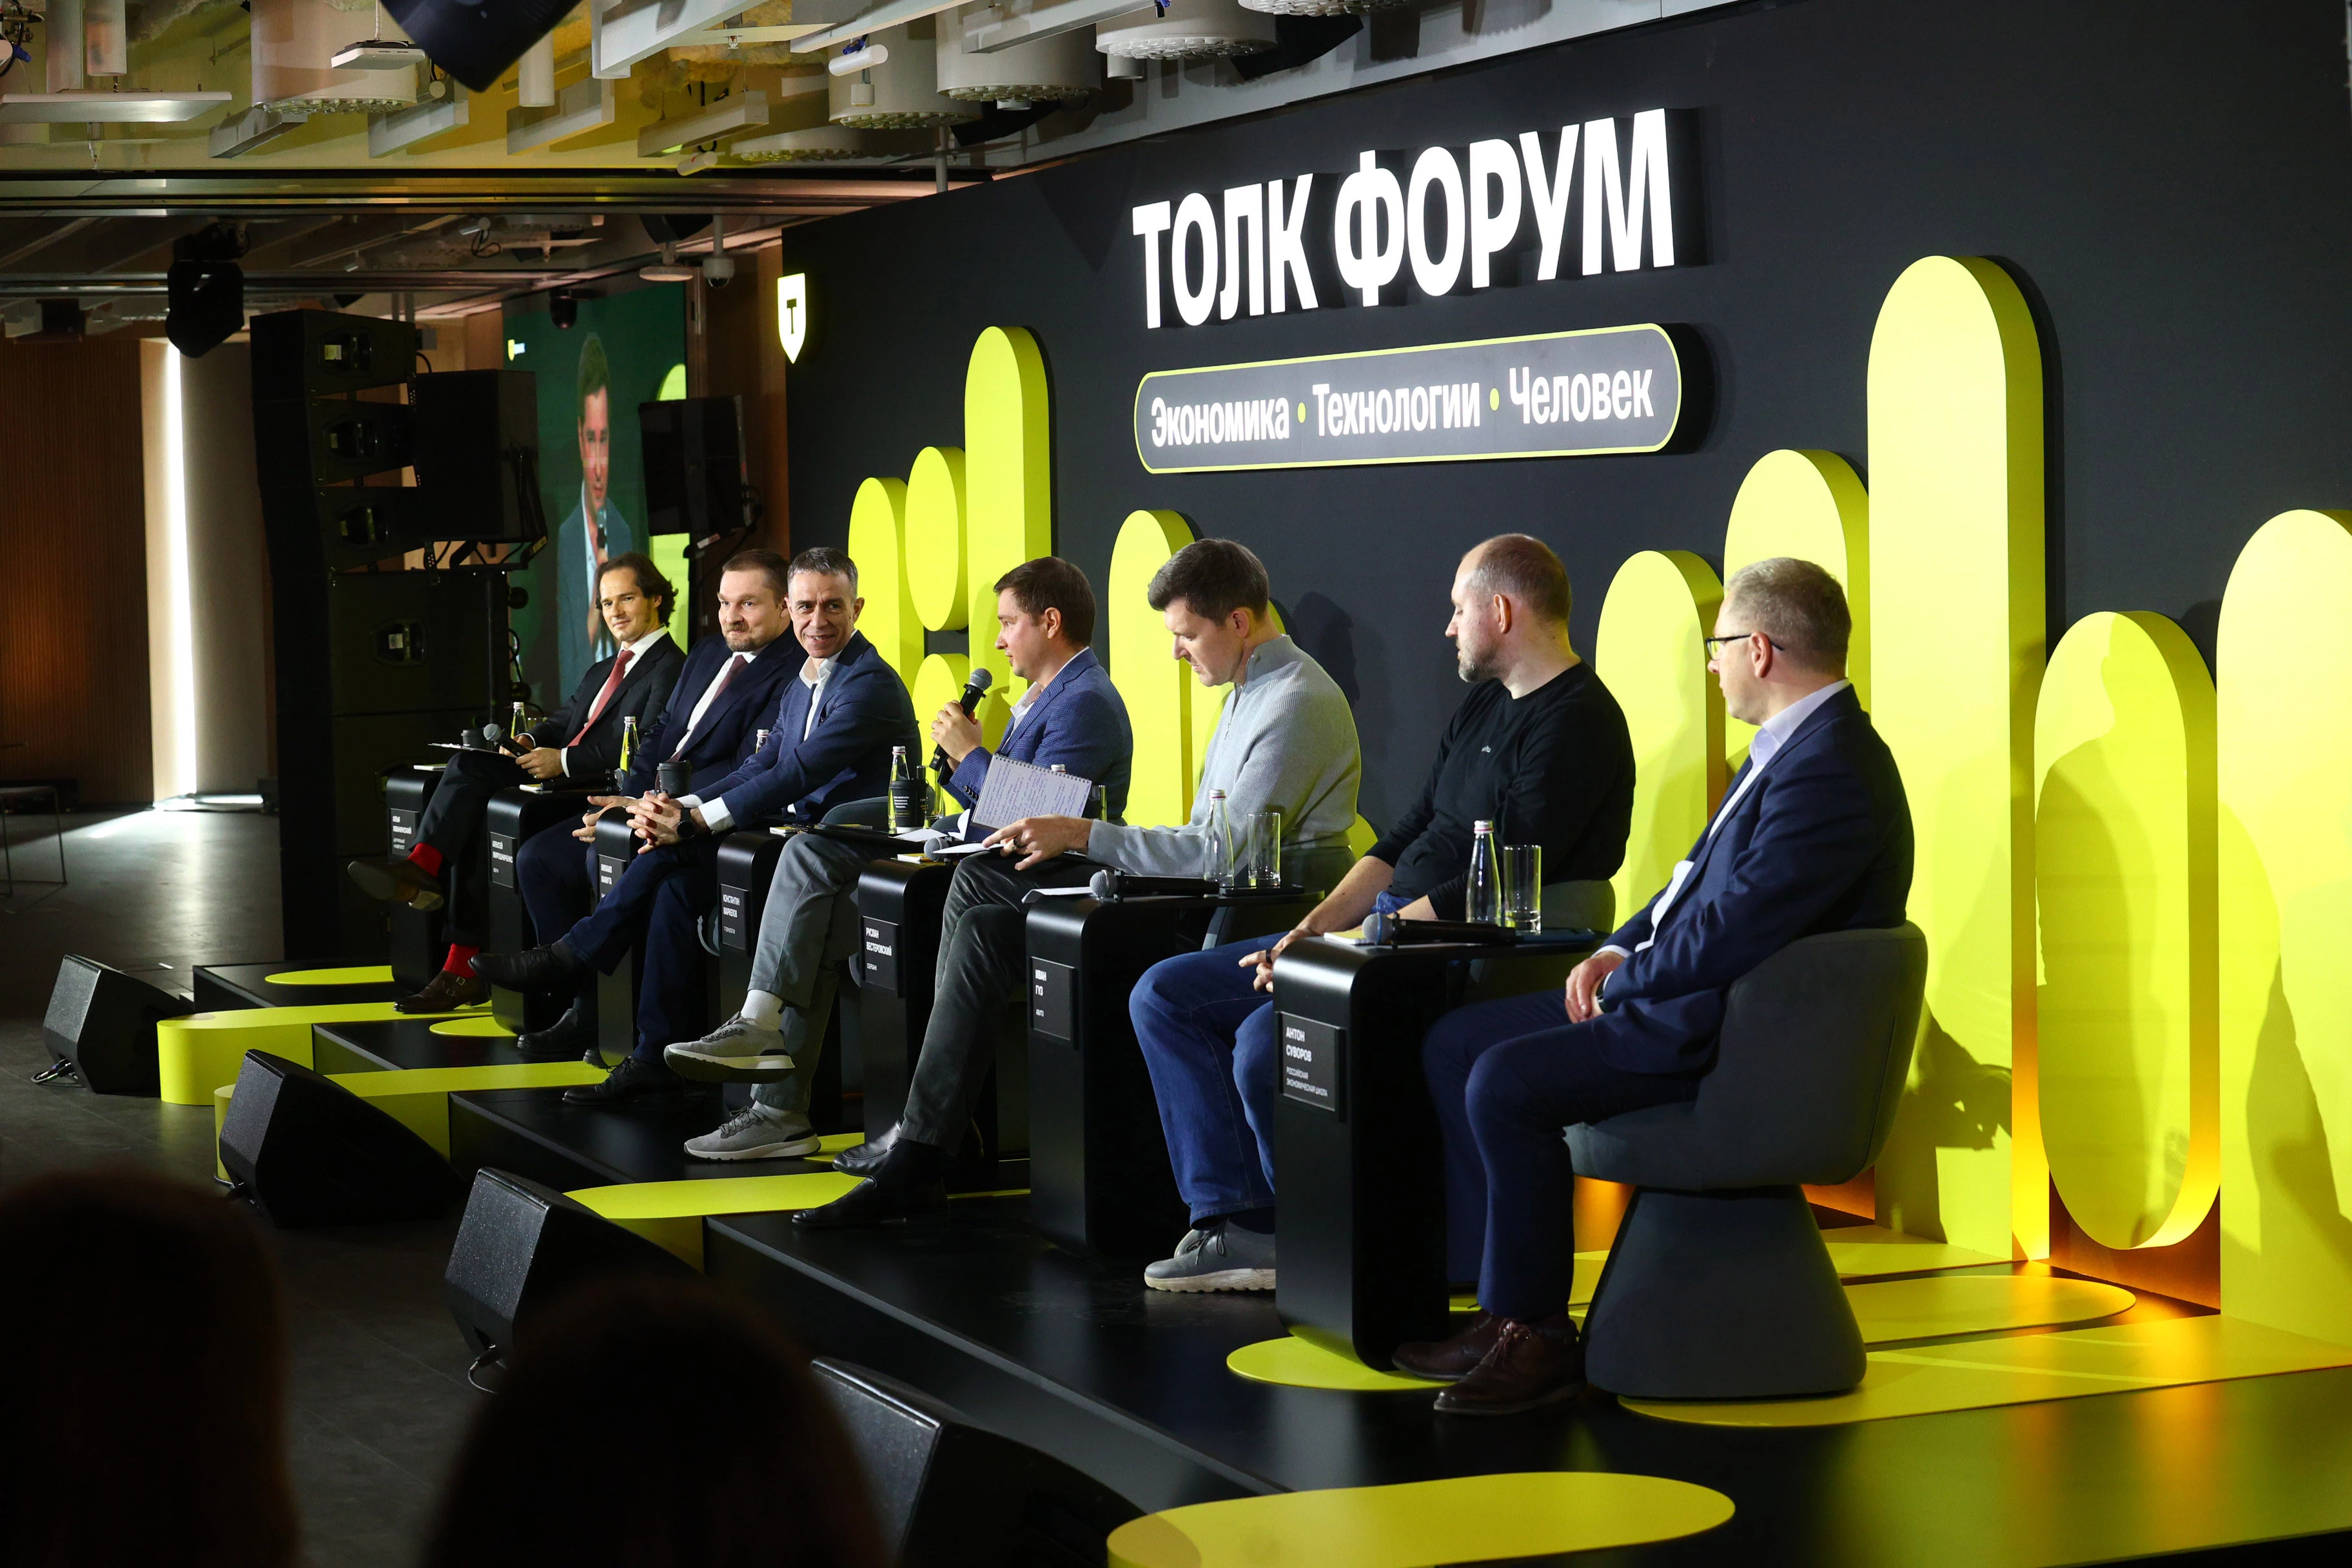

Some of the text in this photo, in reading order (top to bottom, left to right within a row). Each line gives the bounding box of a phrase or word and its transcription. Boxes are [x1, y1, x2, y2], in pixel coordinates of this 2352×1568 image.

[1133, 108, 1674, 329] ТОЛК ФОРУМ
[1151, 366, 1655, 447] Экономика Технологии Человек
[866, 927, 879, 939] РУСЛАН
[866, 941, 892, 956] ВЕСТЕРОВСКИЙ
[1035, 969, 1046, 982] ИВАН
[1035, 985, 1044, 996] ГУЗ
[1286, 1026, 1305, 1042] АНТОН
[1286, 1044, 1312, 1062] СУВОРОВ
